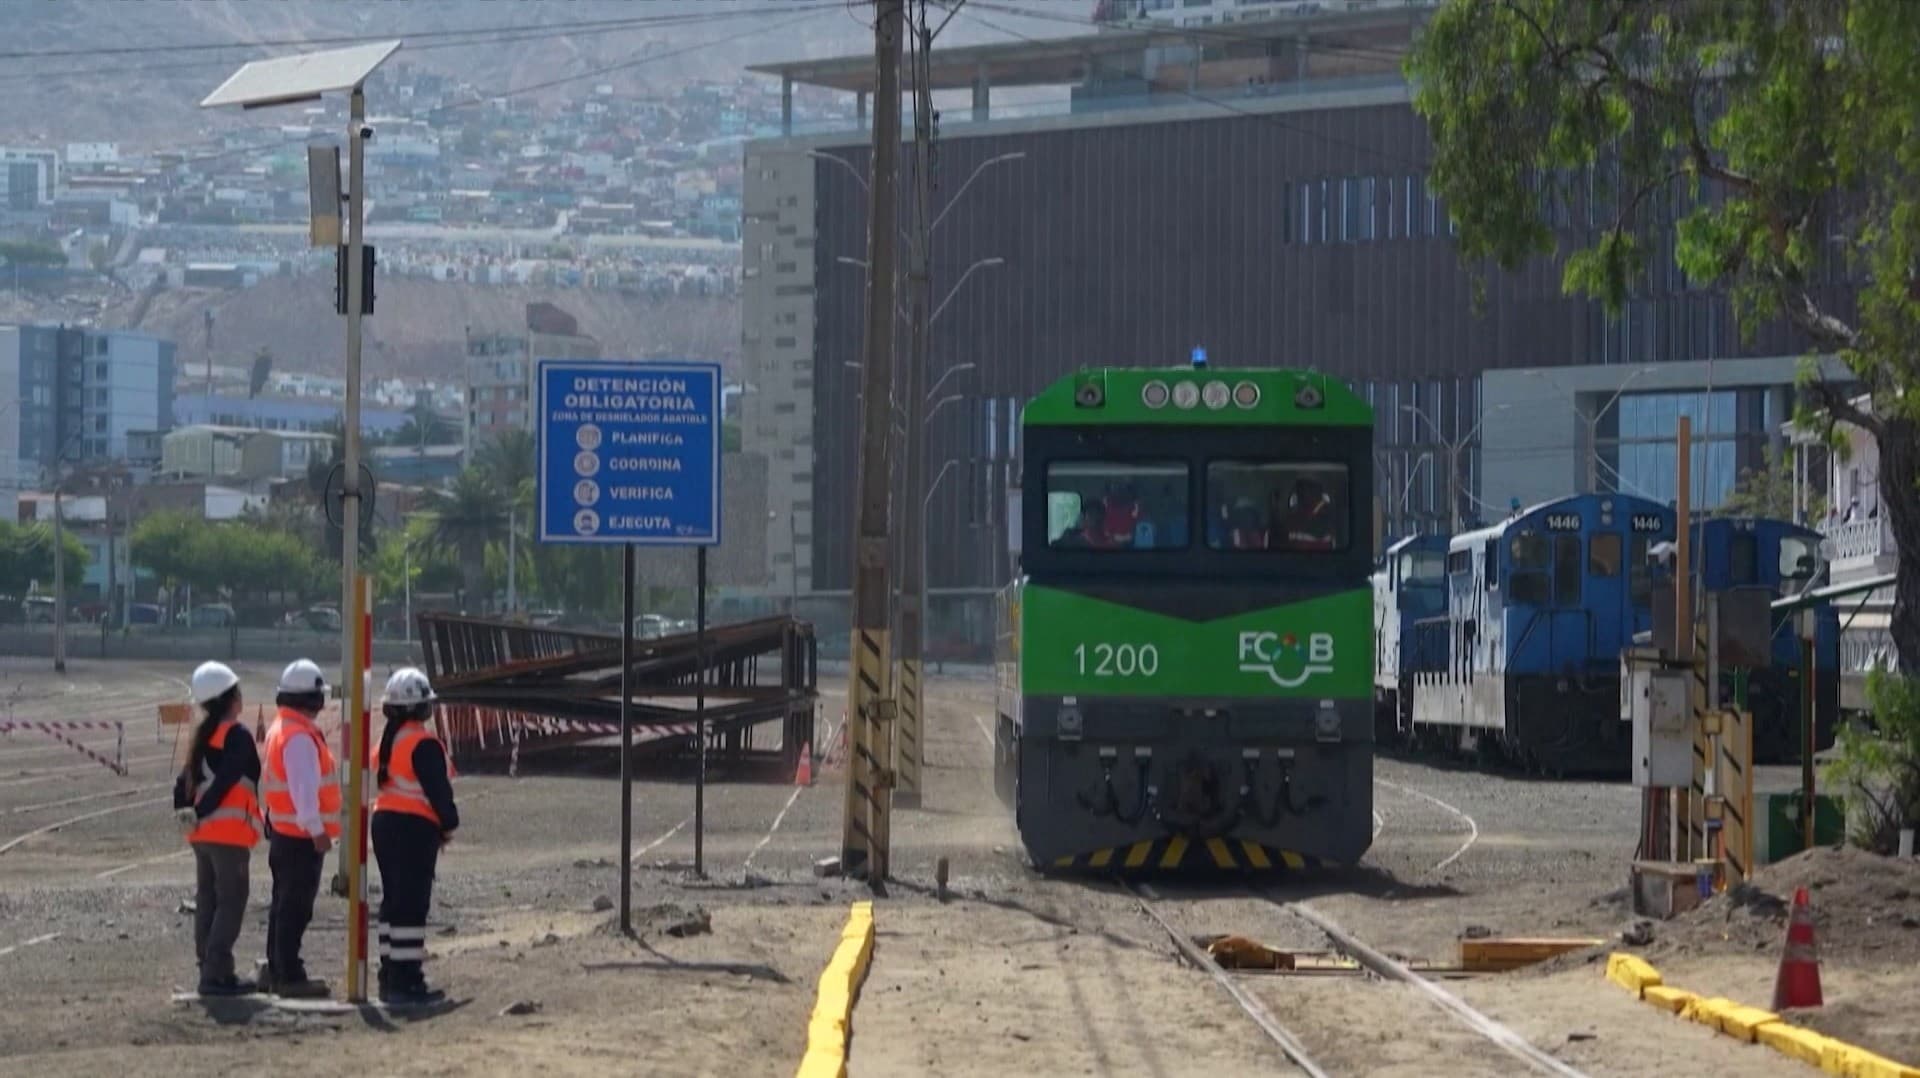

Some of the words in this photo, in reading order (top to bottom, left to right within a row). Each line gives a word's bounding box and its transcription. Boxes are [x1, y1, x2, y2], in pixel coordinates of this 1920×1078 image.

[574, 376, 686, 393] DETENCIÓN
[564, 394, 695, 410] OBLIGATORIA
[552, 411, 578, 421] ZONA
[580, 412, 593, 422] DE
[662, 413, 707, 424] ABATIBLE
[611, 431, 684, 445] PLANIFICA
[609, 457, 682, 471] COORDINA
[609, 486, 673, 500] VERIFICA
[608, 516, 671, 529] EJECUTA
[1547, 515, 1580, 530] 1446
[1632, 515, 1661, 530] 1446
[1074, 643, 1159, 677] 1200
